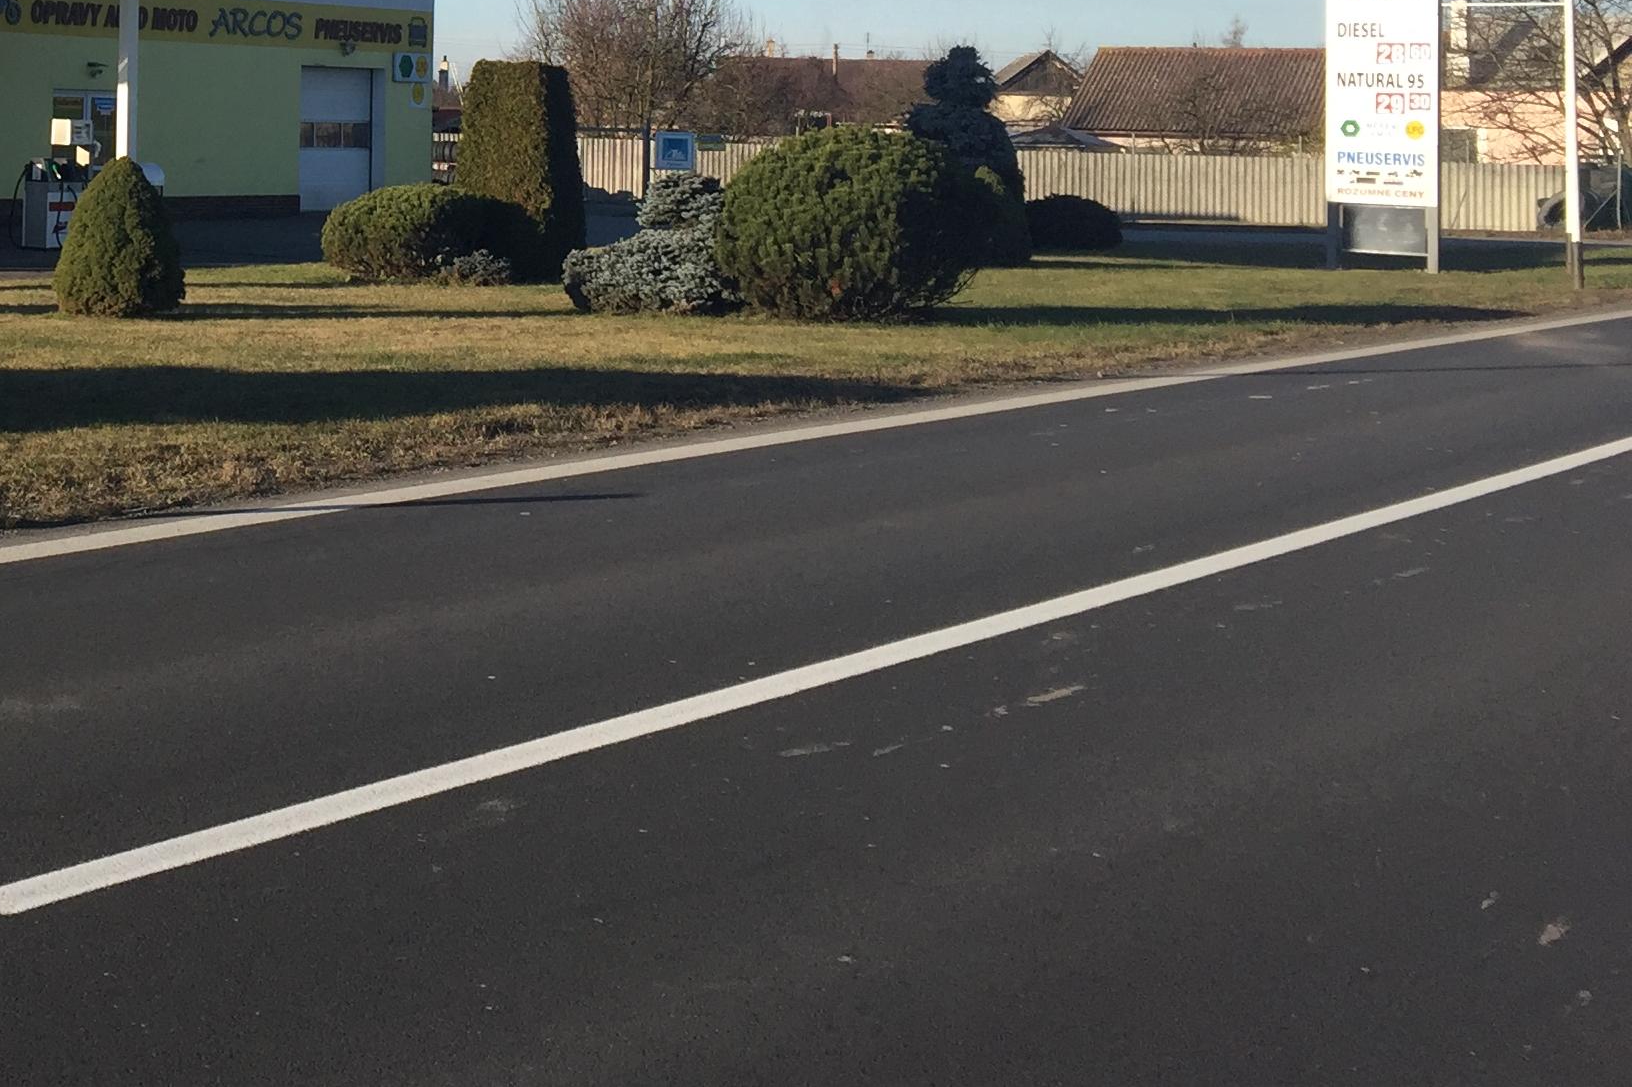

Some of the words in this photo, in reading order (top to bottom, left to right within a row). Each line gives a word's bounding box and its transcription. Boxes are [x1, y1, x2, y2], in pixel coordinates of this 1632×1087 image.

[31, 0, 102, 27] OPRAVY
[151, 7, 198, 33] MOTO
[209, 8, 303, 40] ARCOS
[314, 17, 402, 44] PNEUSERVIS
[1337, 22, 1384, 38] DIESEL
[1337, 72, 1403, 88] NATURAL
[1408, 73, 1424, 89] 95
[1376, 93, 1404, 114] 29
[1410, 93, 1430, 110] 30
[1337, 151, 1425, 167] PNEUSERVIS
